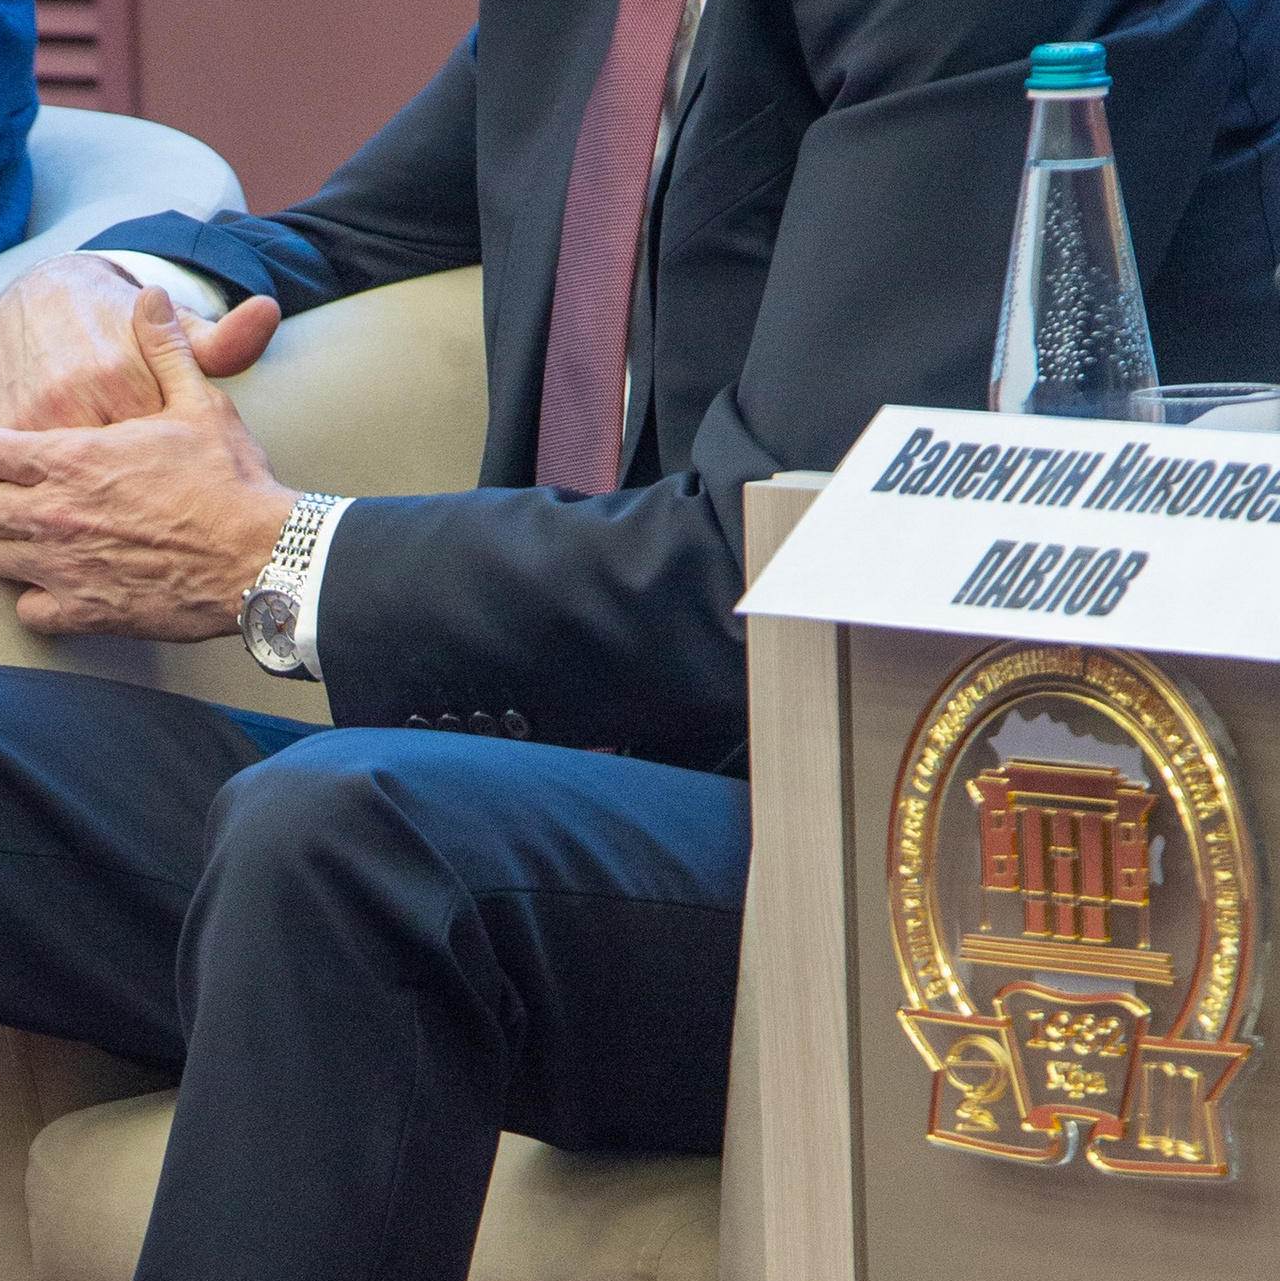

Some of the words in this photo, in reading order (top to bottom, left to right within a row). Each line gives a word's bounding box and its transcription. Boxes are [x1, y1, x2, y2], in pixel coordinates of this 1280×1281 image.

[871, 427, 1106, 506] Валентин
[1082, 442, 1280, 522] Николае
[951, 539, 1150, 617] ПАВЛОВ
[1025, 1009, 1128, 1058] 1932
